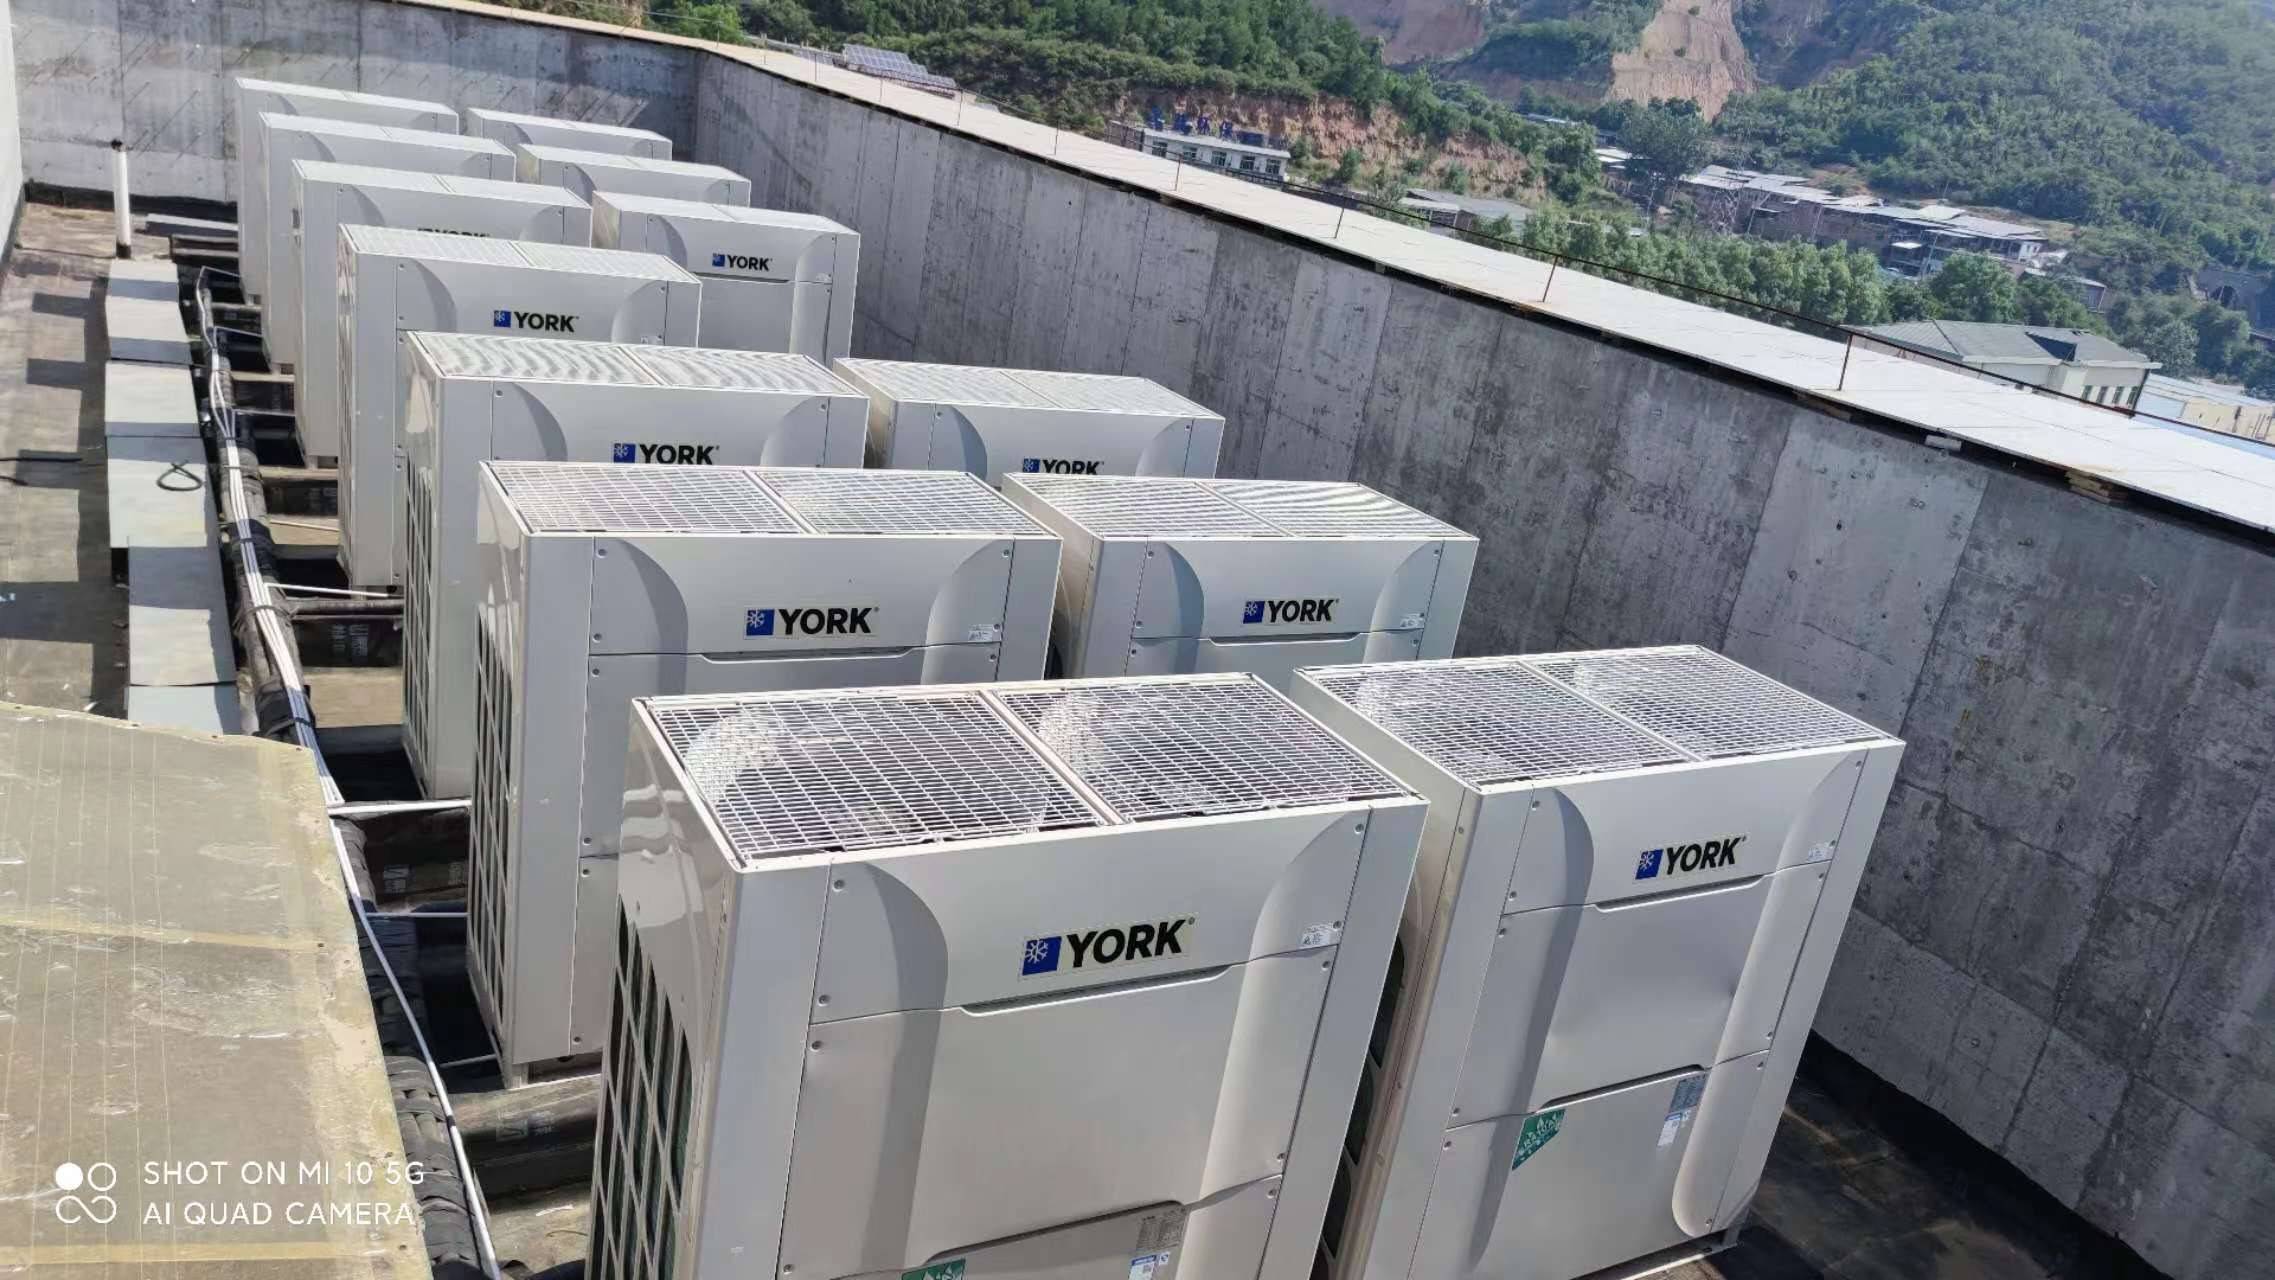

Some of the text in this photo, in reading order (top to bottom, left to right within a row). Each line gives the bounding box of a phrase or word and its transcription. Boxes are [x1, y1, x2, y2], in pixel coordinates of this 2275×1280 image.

[727, 254, 769, 272] YORK
[513, 311, 575, 333] YORK
[639, 444, 714, 465] YORK
[1042, 459, 1100, 475] YORK
[778, 607, 872, 636] YORK
[1267, 599, 1334, 623] YORK
[1666, 837, 1741, 875] YORK
[1066, 919, 1186, 968] YORK
